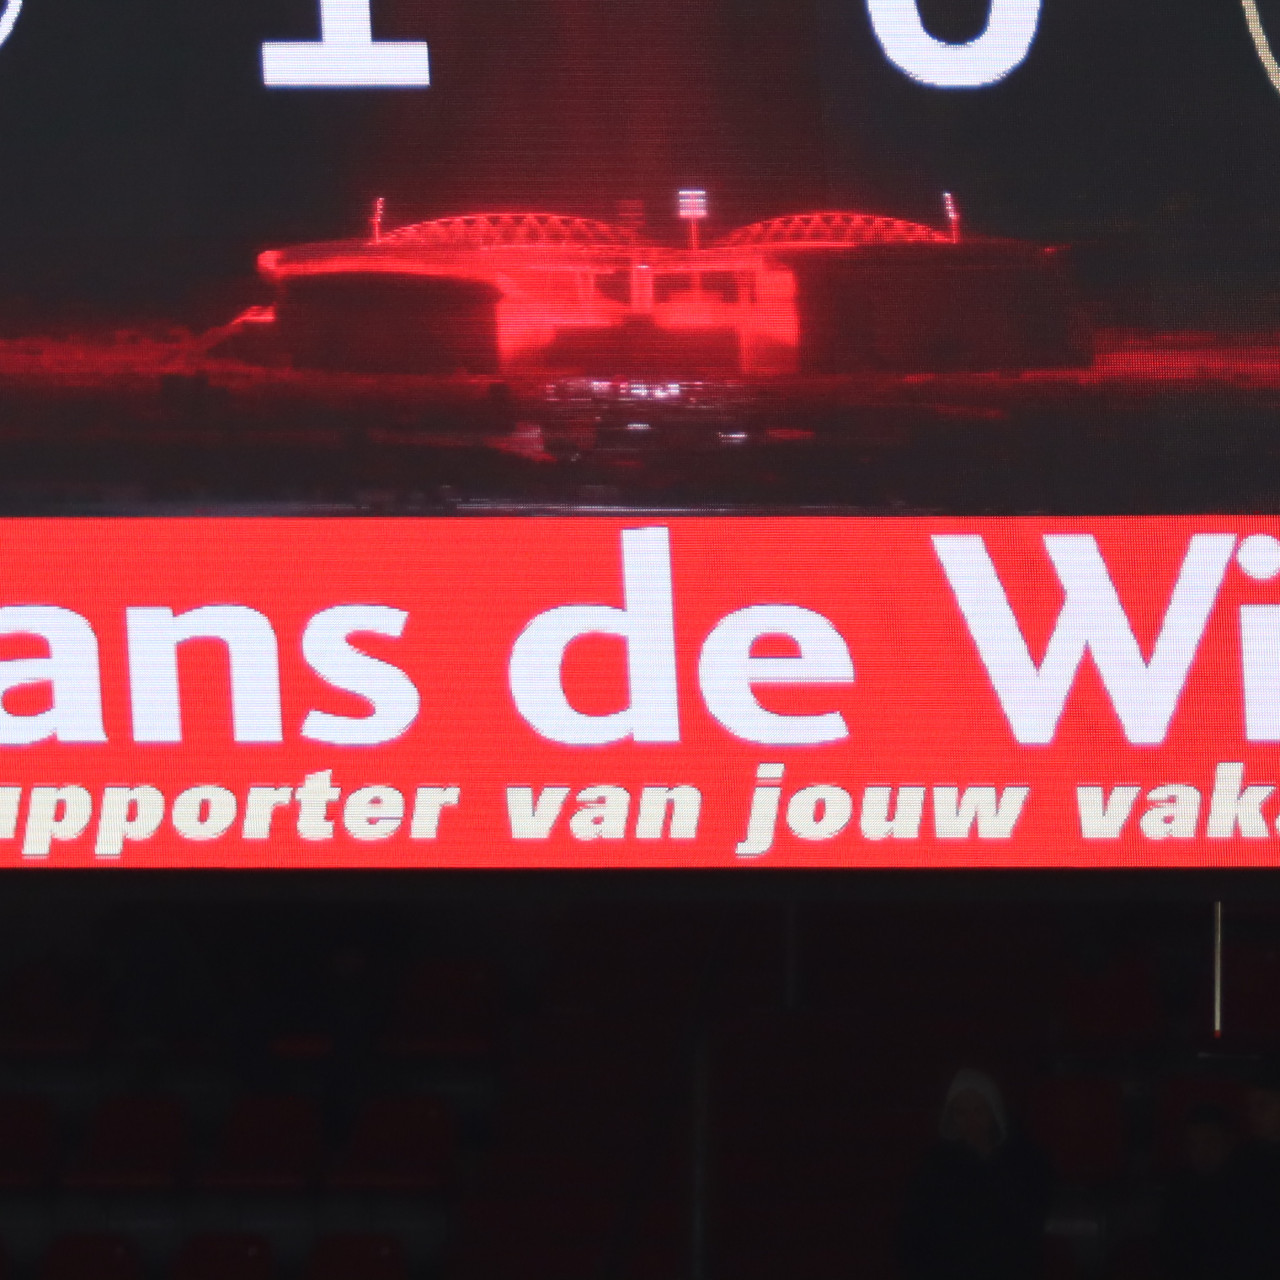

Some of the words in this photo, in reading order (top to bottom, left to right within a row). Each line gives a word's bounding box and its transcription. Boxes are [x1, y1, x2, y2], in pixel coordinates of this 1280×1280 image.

[507, 525, 856, 747] de
[505, 783, 703, 841] van
[734, 762, 1032, 857] jouw
